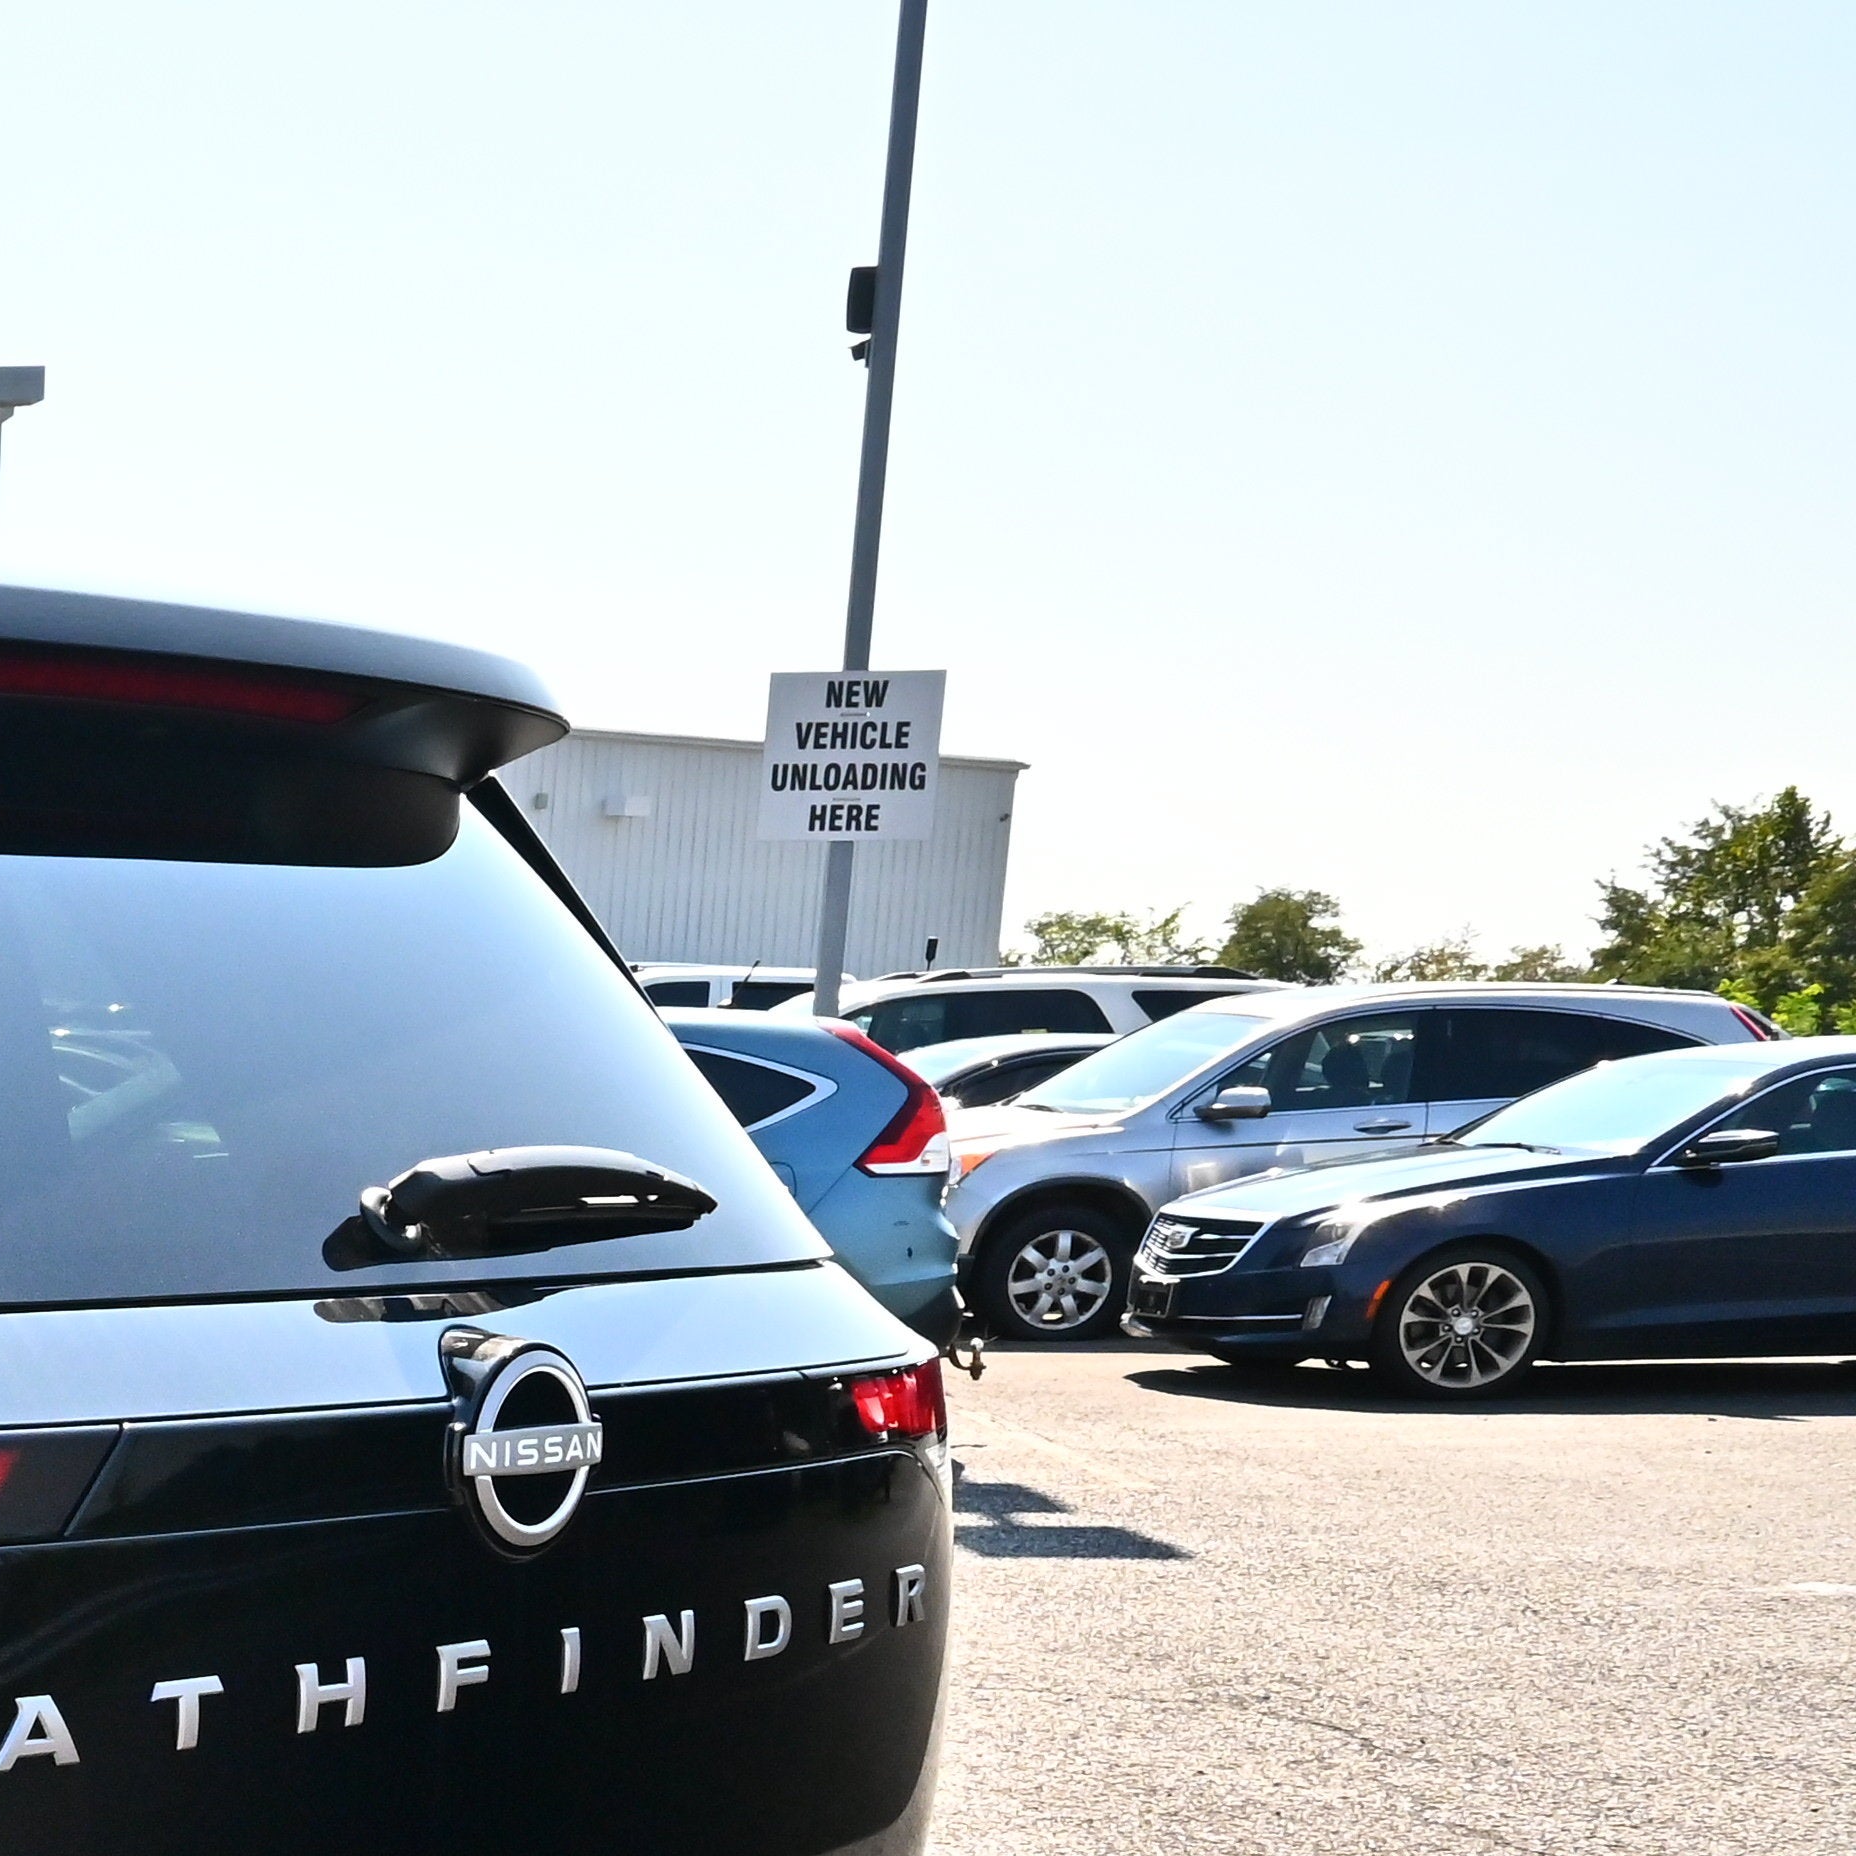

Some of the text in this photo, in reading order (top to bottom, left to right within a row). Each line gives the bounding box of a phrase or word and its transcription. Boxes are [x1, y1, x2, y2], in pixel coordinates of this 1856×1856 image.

[825, 679, 890, 709] NEW
[795, 720, 911, 750] VEHICLE
[770, 761, 927, 792] UNLOADING
[808, 803, 881, 832] HERE
[470, 1430, 602, 1470] NISSAN
